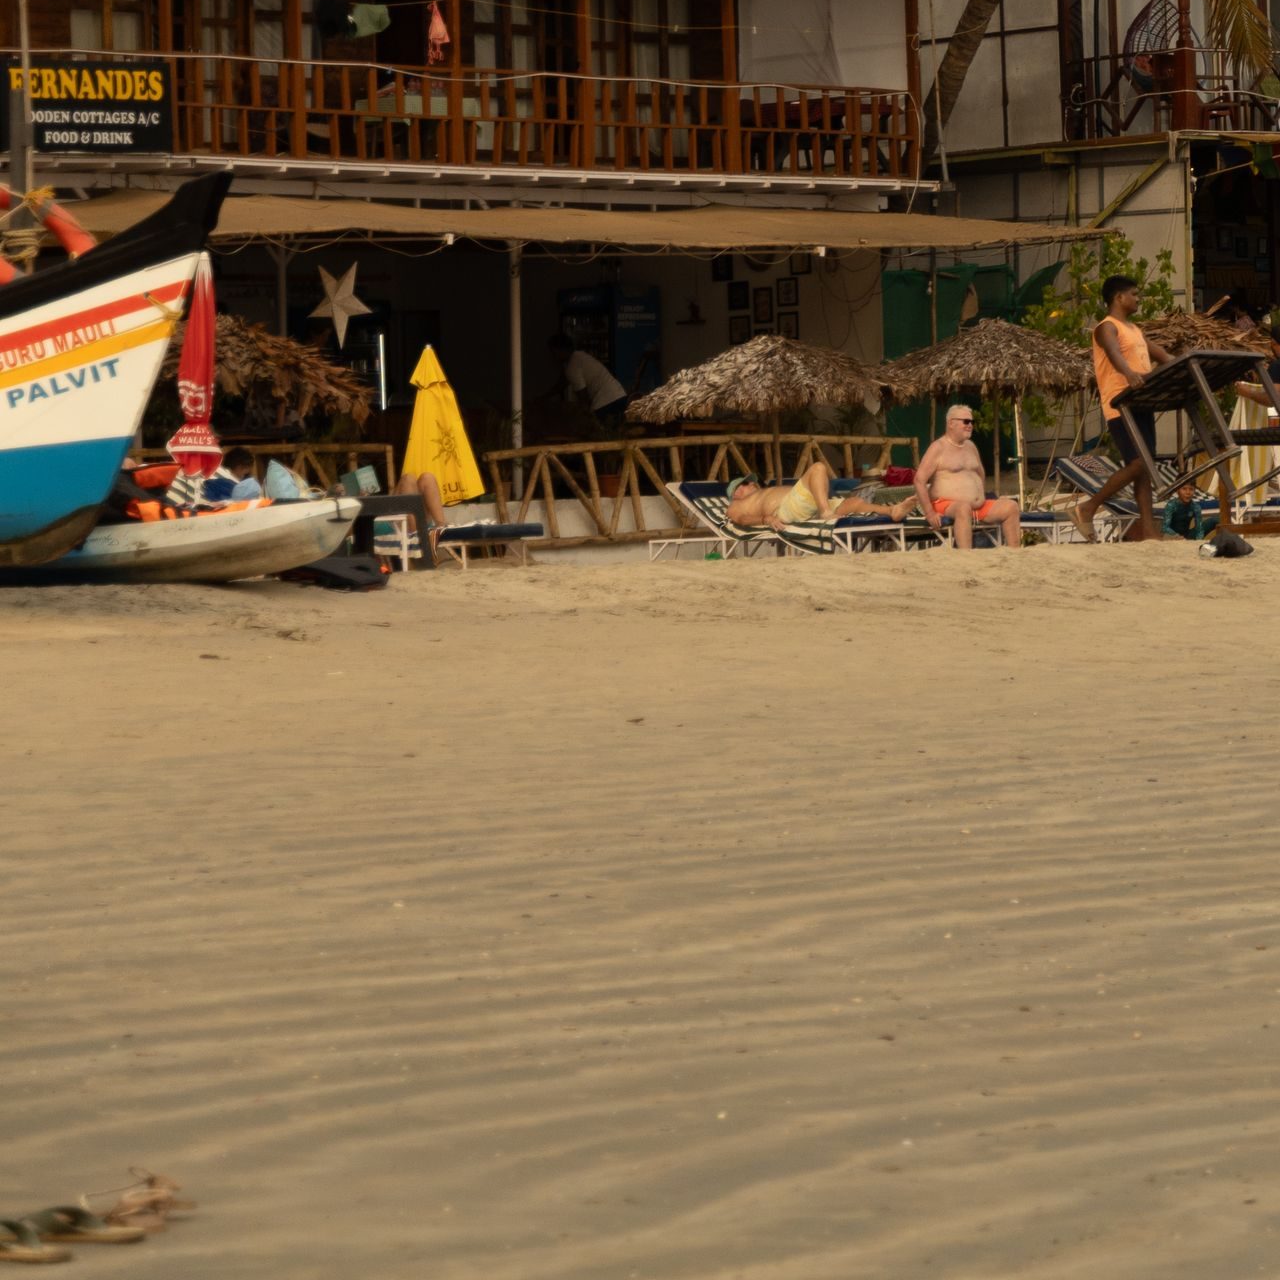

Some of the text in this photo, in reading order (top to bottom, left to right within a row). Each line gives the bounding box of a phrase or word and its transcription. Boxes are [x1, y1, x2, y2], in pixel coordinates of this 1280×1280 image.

[9, 67, 164, 101] FERNANDES
[72, 111, 136, 125] COTTAGES
[137, 113, 160, 127] A/C
[44, 131, 134, 145] FOOD & DRINK
[53, 319, 117, 354] MAULI
[6, 357, 120, 410] PALVIT
[178, 435, 214, 446] WALL'S
